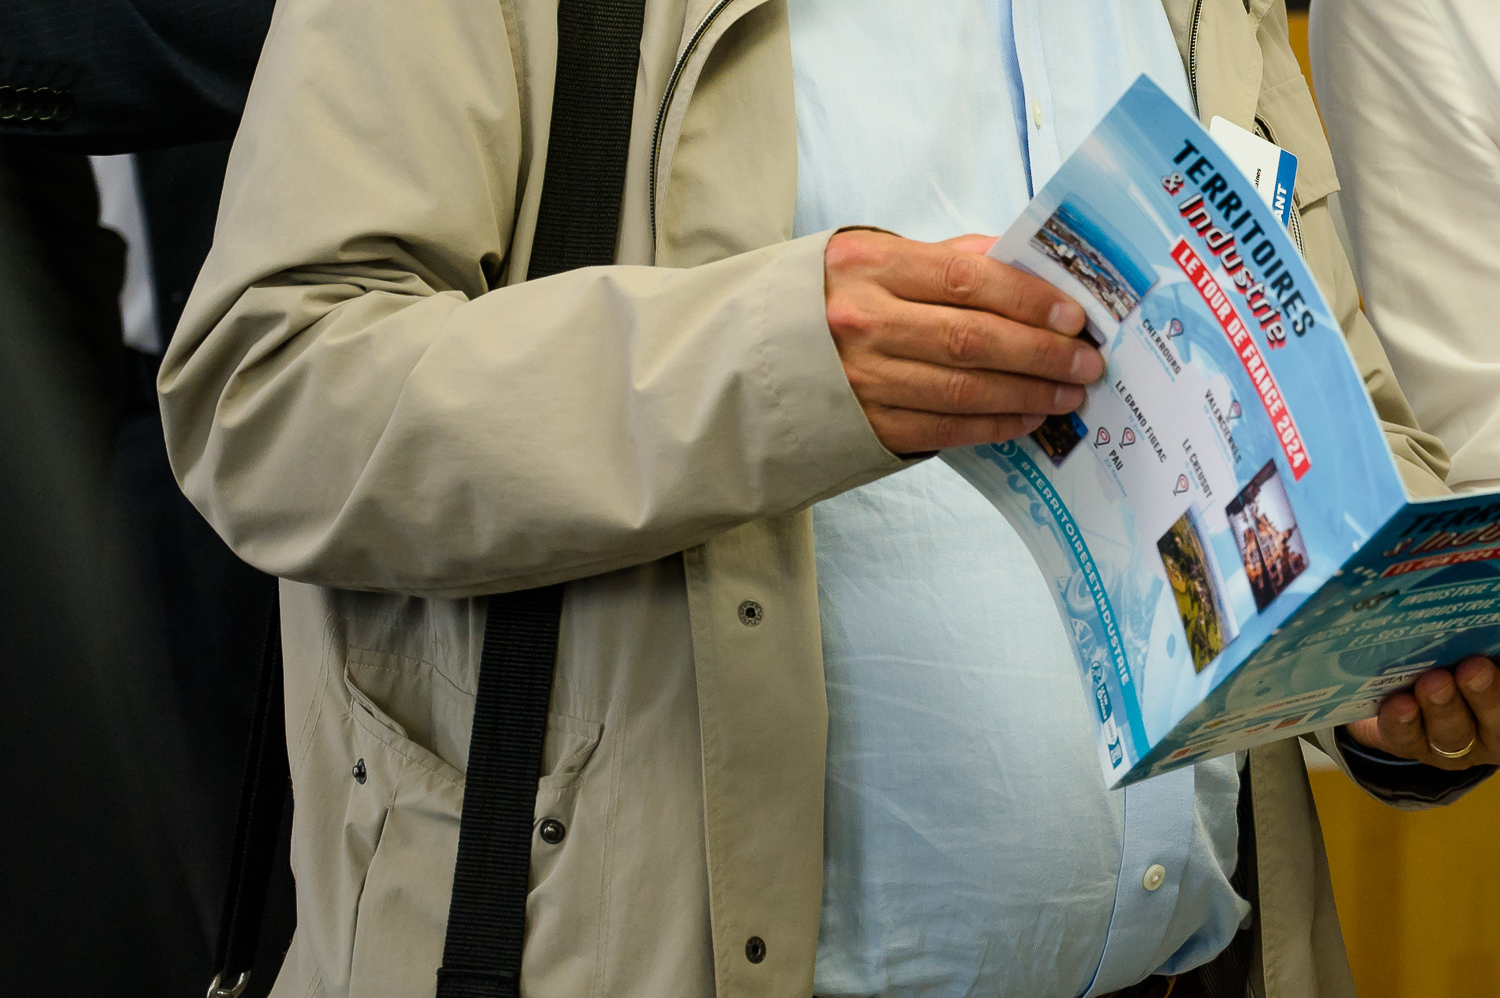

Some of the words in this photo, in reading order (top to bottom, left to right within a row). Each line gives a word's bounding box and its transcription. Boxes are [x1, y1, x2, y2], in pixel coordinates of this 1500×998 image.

[1161, 172, 1184, 197] &
[1179, 193, 1286, 349] Industrie
[1173, 139, 1315, 337] TERRITOIRES
[1142, 319, 1182, 375] CHERBOURG
[1178, 249, 1200, 275] LE
[1197, 271, 1232, 321] TOUR
[1226, 319, 1247, 347] DE
[1241, 345, 1282, 416] FRANCE
[1276, 415, 1306, 468] 2024
[1115, 380, 1126, 395] LE
[1125, 393, 1147, 427] GRAND
[1145, 426, 1167, 463] FIGEAC
[1204, 389, 1242, 464] VALENCIENNES
[1108, 449, 1124, 471] PAU
[1182, 438, 1193, 453] LE
[1189, 453, 1212, 498] CREUSOT
[1021, 461, 1130, 686] #TERRITOIRESETINDUSTRIE
[1400, 582, 1487, 606] INDUSTRIE
[1375, 628, 1407, 643] SES
